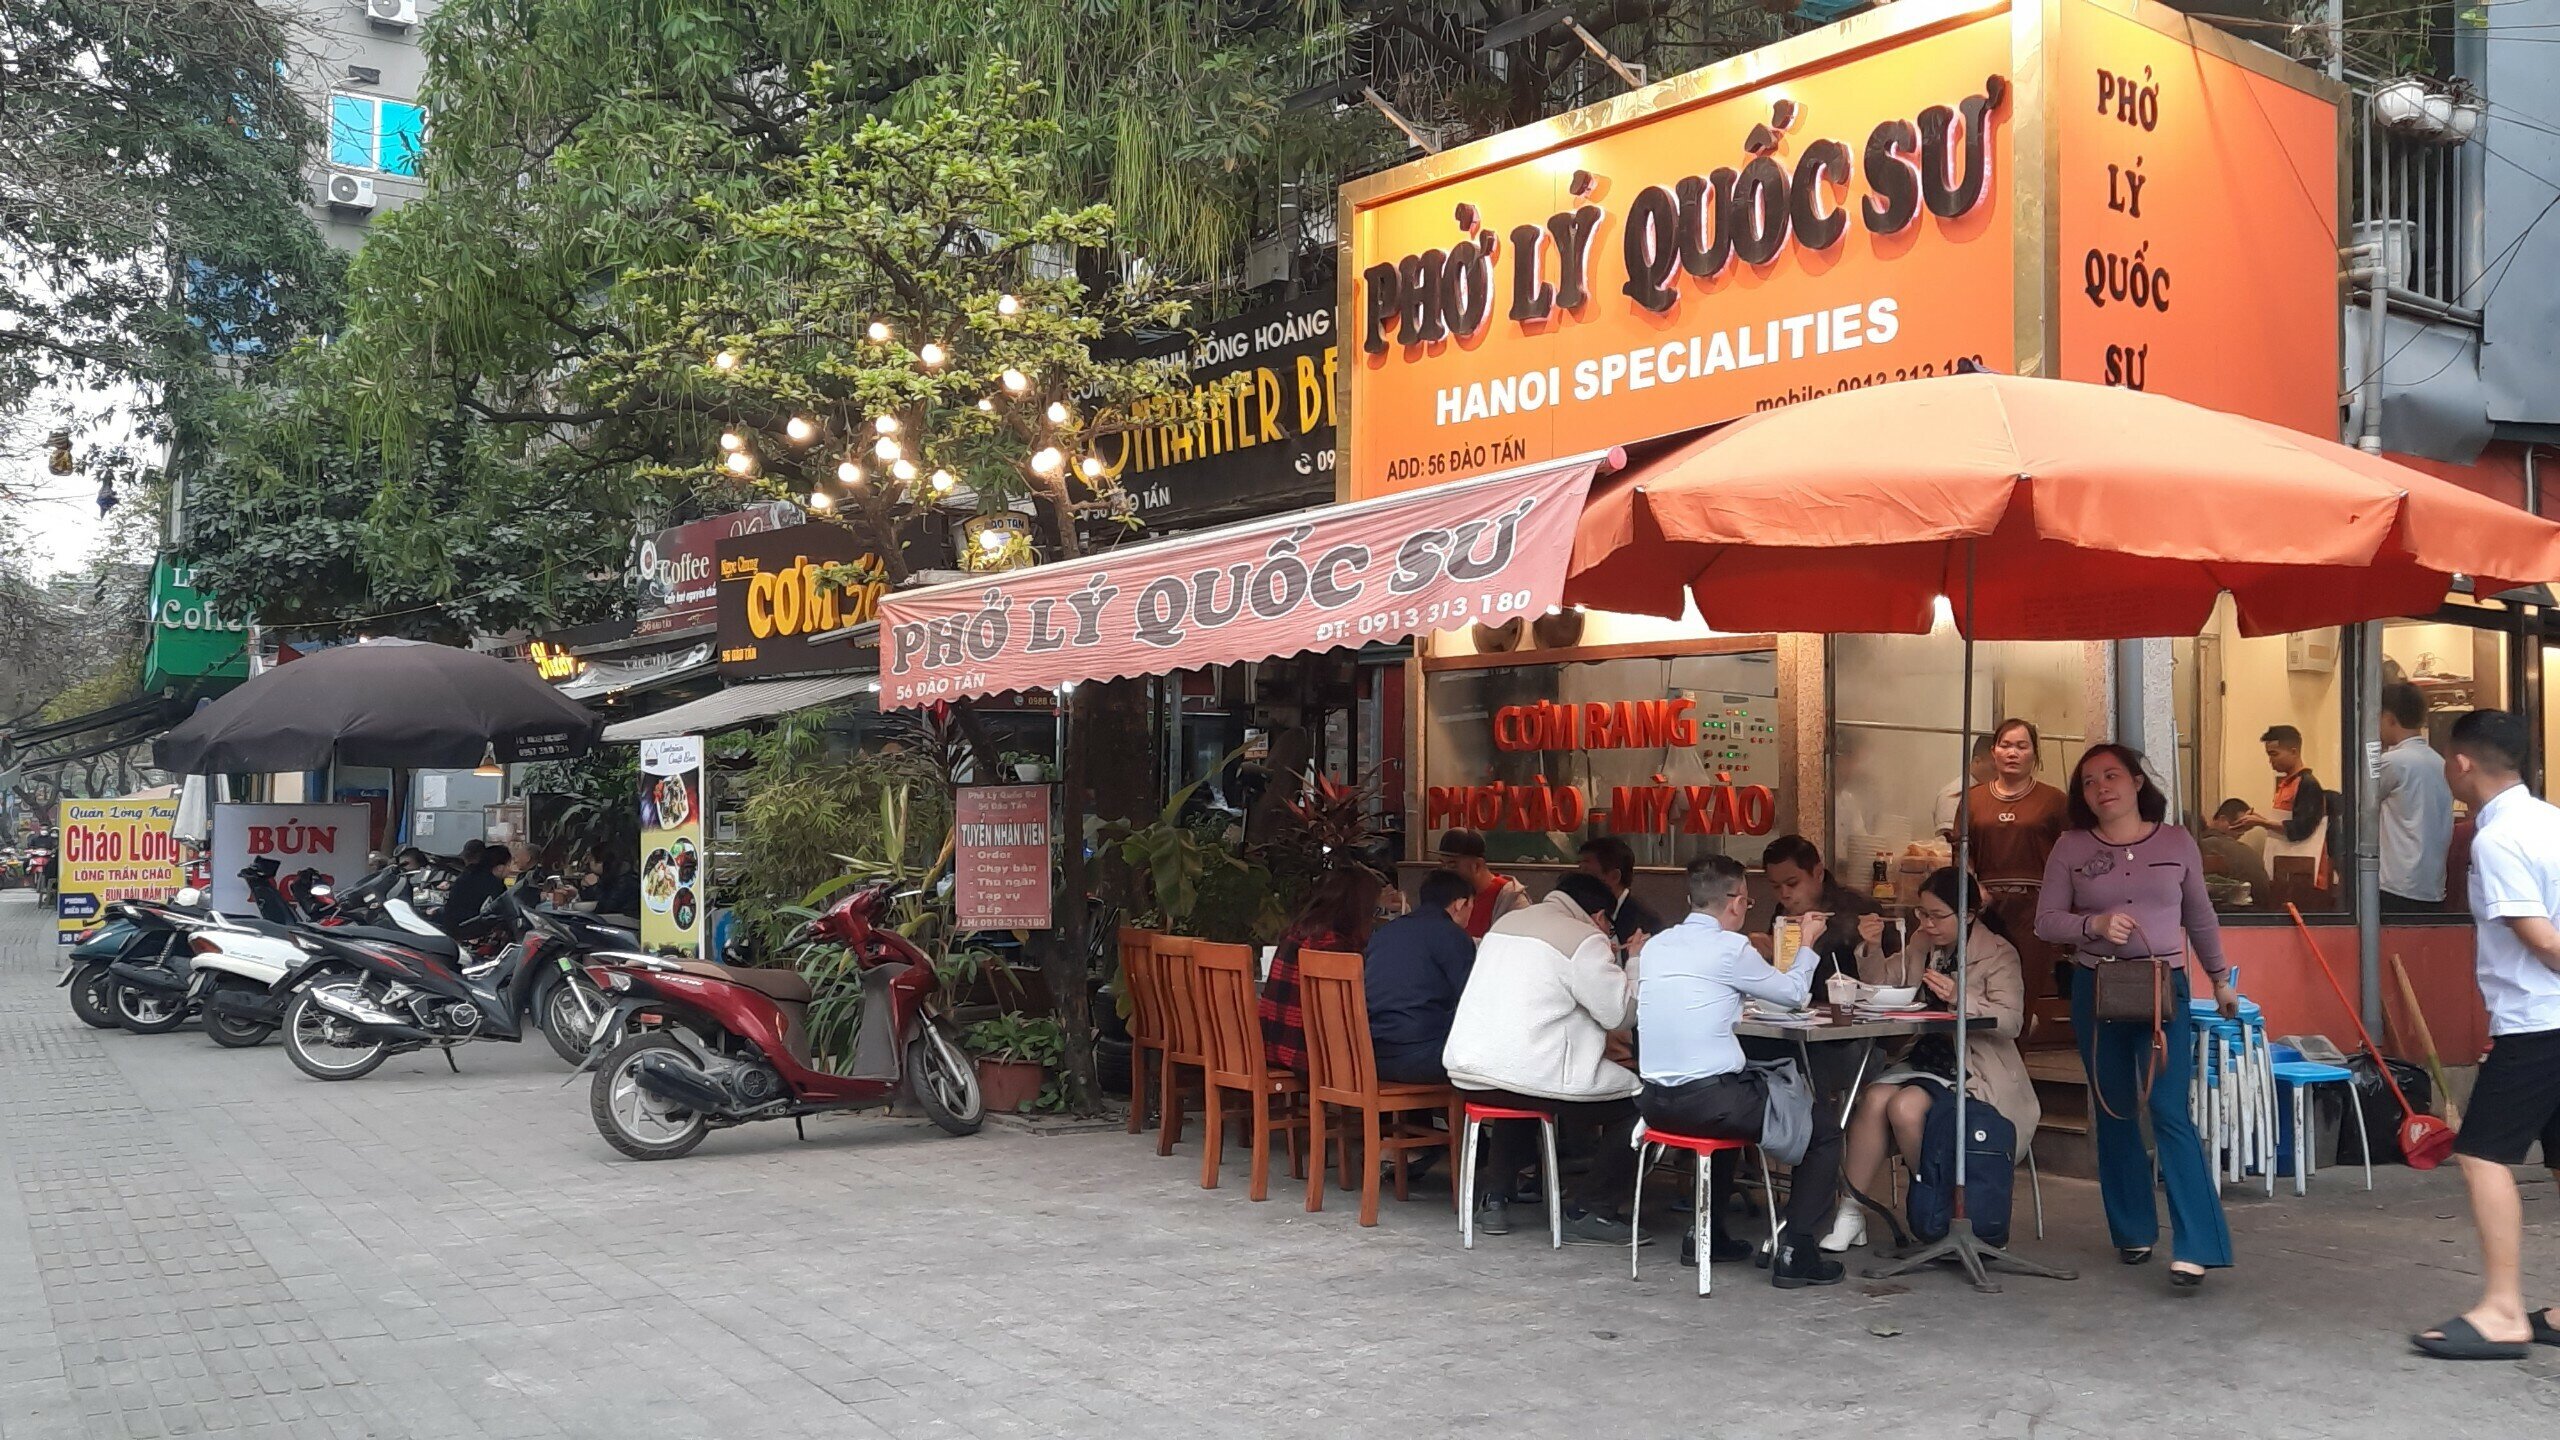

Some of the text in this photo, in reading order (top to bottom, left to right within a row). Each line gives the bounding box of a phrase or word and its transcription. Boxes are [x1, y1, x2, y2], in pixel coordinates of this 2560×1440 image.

[2097, 65, 2159, 132] PHỞ
[2107, 156, 2146, 218] LÝ
[1363, 74, 2009, 353] PHỞ LÝ QUỐC SƯ
[2085, 240, 2170, 312] QUỐC
[1254, 309, 1331, 354] HOÀNG
[1436, 298, 1899, 426] HANOI SPECIALITIES
[2105, 344, 2147, 391] SƯ
[1387, 434, 1527, 482] ADD: 56 ĐÀO TẤN
[1143, 482, 1171, 509] TẤN
[659, 553, 710, 585] Coffee
[892, 496, 1539, 675] PHỞ LÝ QUỐC SƯ
[747, 555, 843, 639] CƠM
[1316, 589, 1532, 641] ĐT: 0913 313 180
[896, 668, 986, 700] 56 ĐÀO TẤN
[1494, 699, 1698, 751] CƠM RANG
[70, 805, 104, 820] Quán
[109, 805, 143, 820] Lòng
[1505, 773, 1584, 832] XÀO
[1684, 771, 1776, 836] XÀO
[66, 823, 181, 866] Cháo Lòng
[247, 817, 338, 855] BÚN
[961, 812, 1045, 848] TUYỂN NHÂN VIÊN
[142, 866, 172, 880] CHÁO
[977, 850, 1013, 860] Order
